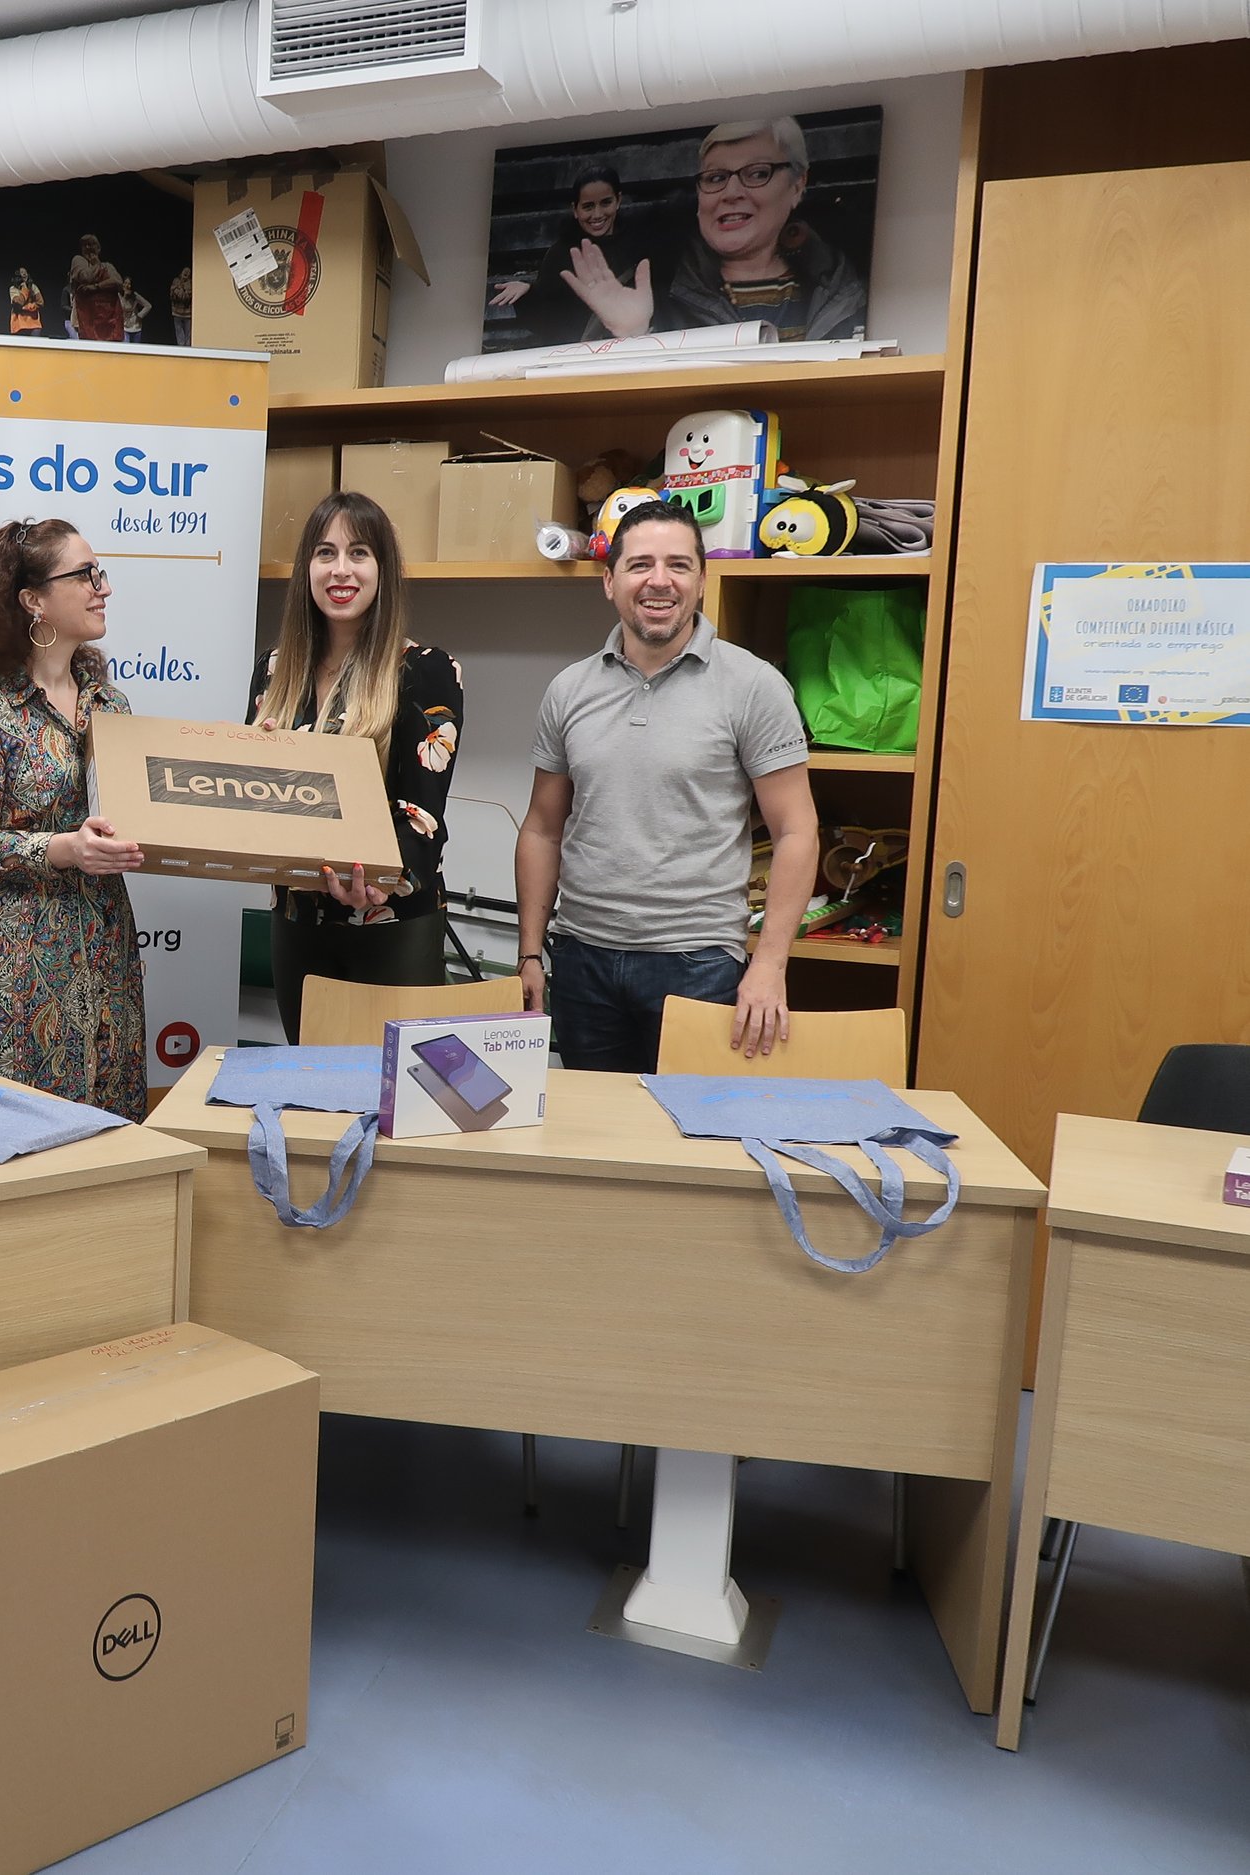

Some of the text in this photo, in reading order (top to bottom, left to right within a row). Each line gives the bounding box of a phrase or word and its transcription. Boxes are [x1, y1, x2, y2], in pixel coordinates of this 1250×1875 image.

[29, 444, 99, 493] do
[113, 446, 209, 497] Sur
[110, 507, 207, 536] desde 1991
[1127, 598, 1187, 613] OBRADOIRO
[1075, 619, 1236, 636] COMPETENCIA DIXITAL BÁSICA
[1083, 638, 1224, 655] orientada ao emprego
[106, 645, 201, 682] nciales.
[163, 766, 323, 807] Lenovo
[483, 1029, 523, 1040] Lenovo
[483, 1038, 546, 1053] Tab M10 HD
[102, 1619, 154, 1656] DELL
